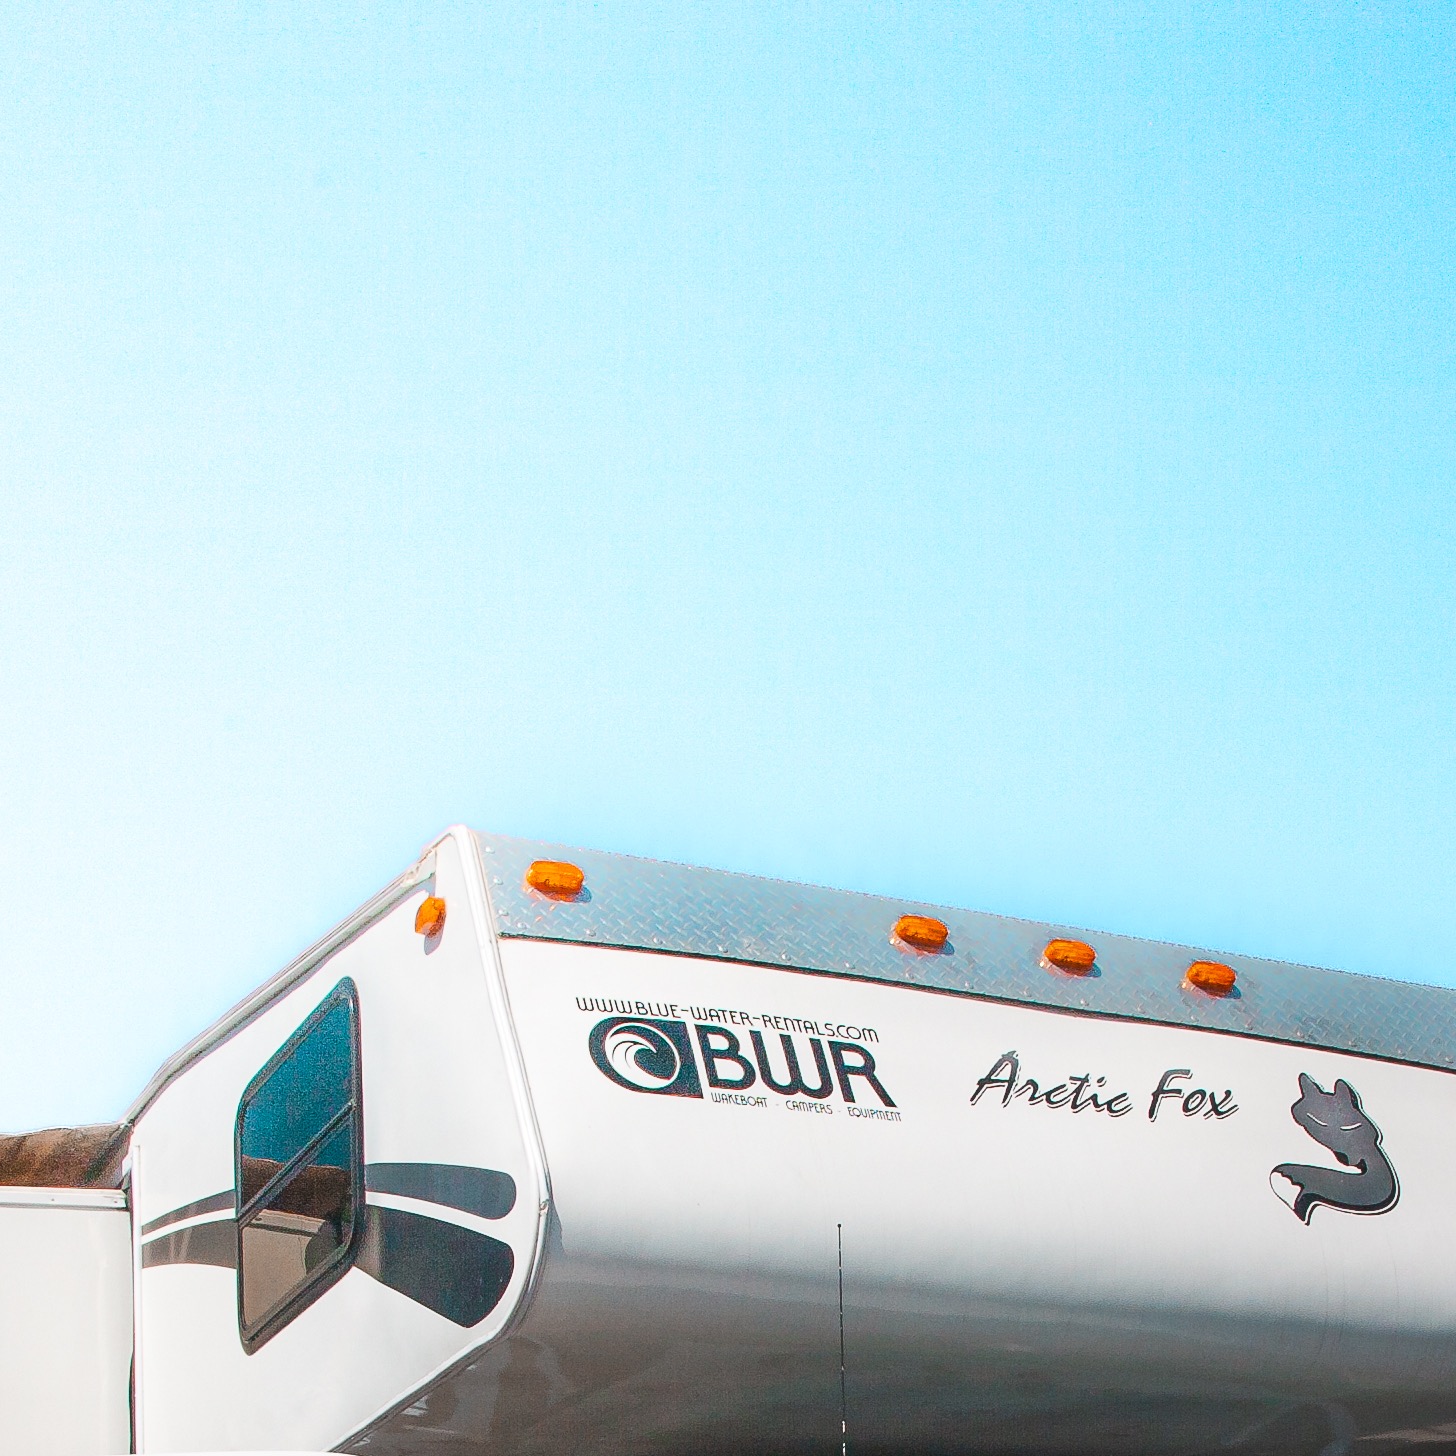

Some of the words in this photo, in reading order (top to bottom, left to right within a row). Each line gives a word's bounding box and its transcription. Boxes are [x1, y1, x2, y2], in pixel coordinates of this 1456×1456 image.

[575, 997, 880, 1042] WWW.BLUE-WATER-RENTALS.COM
[694, 1023, 898, 1108] BWR
[969, 1049, 1134, 1118] Arctic
[1147, 1068, 1240, 1123] Fox
[711, 1092, 768, 1108] WAKEBOAT
[785, 1100, 833, 1115] CAMPERS
[847, 1106, 902, 1122] EQUIPMENT
